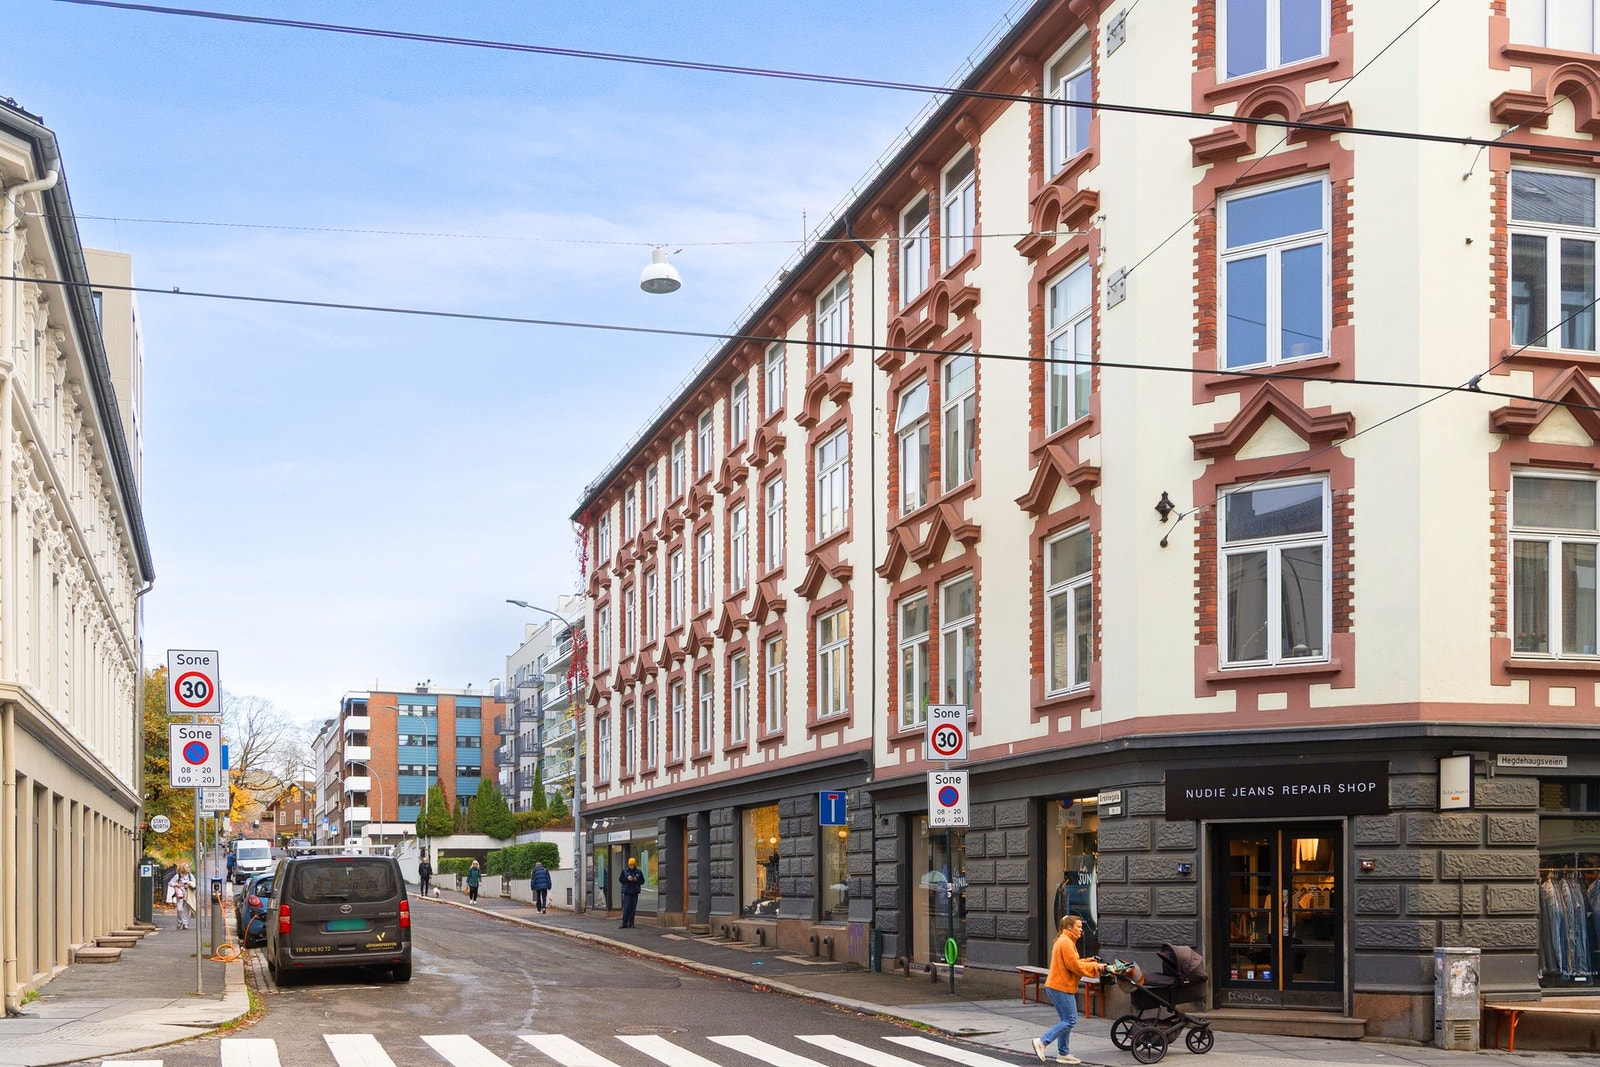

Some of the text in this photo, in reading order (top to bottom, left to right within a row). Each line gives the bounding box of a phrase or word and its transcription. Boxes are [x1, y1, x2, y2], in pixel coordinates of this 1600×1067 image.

[176, 654, 210, 665] Sone
[182, 681, 207, 698] 30
[934, 708, 960, 718] Sone
[179, 728, 212, 739] Sone
[938, 732, 957, 748] 30
[1501, 756, 1563, 766] Hegdehaugsveien
[935, 774, 962, 784] Sone
[1186, 782, 1377, 798] NUDIE JEANS REPAIR SHOP
